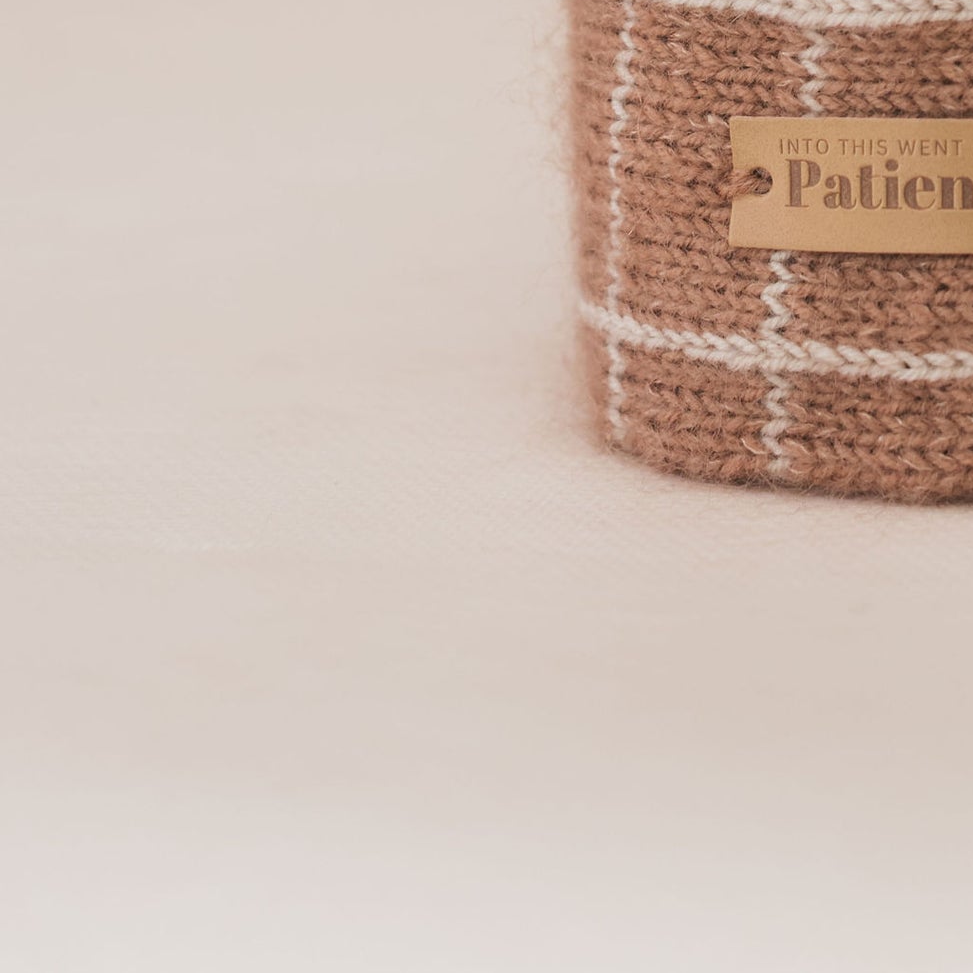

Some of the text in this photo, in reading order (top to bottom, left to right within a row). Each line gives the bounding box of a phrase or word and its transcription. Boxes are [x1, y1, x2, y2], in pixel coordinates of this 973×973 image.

[779, 138, 829, 155] INTO
[838, 139, 888, 156] THIS
[899, 139, 963, 156] WENT
